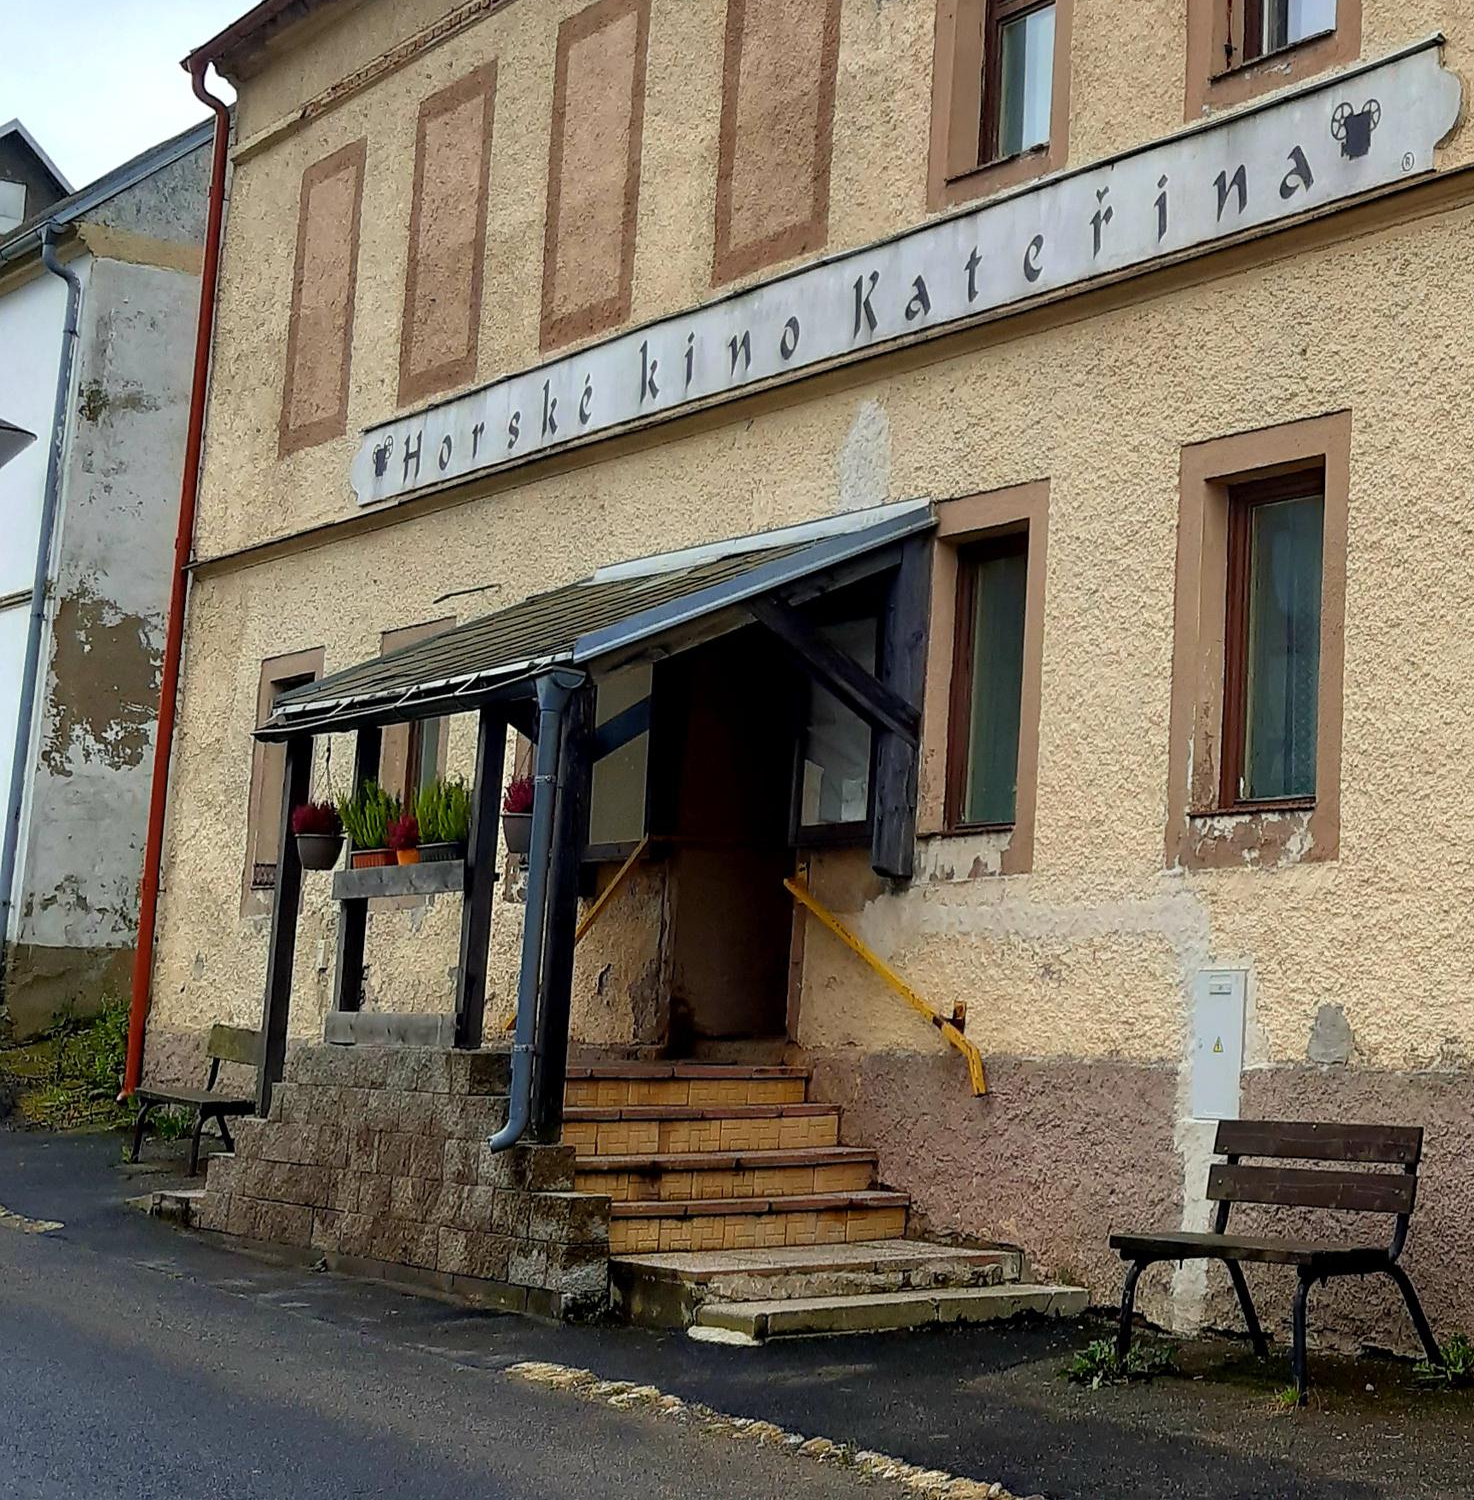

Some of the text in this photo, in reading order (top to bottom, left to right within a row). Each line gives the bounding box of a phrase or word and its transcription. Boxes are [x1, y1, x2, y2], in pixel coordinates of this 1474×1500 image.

[402, 145, 1315, 484] Horské kino Kateřina
